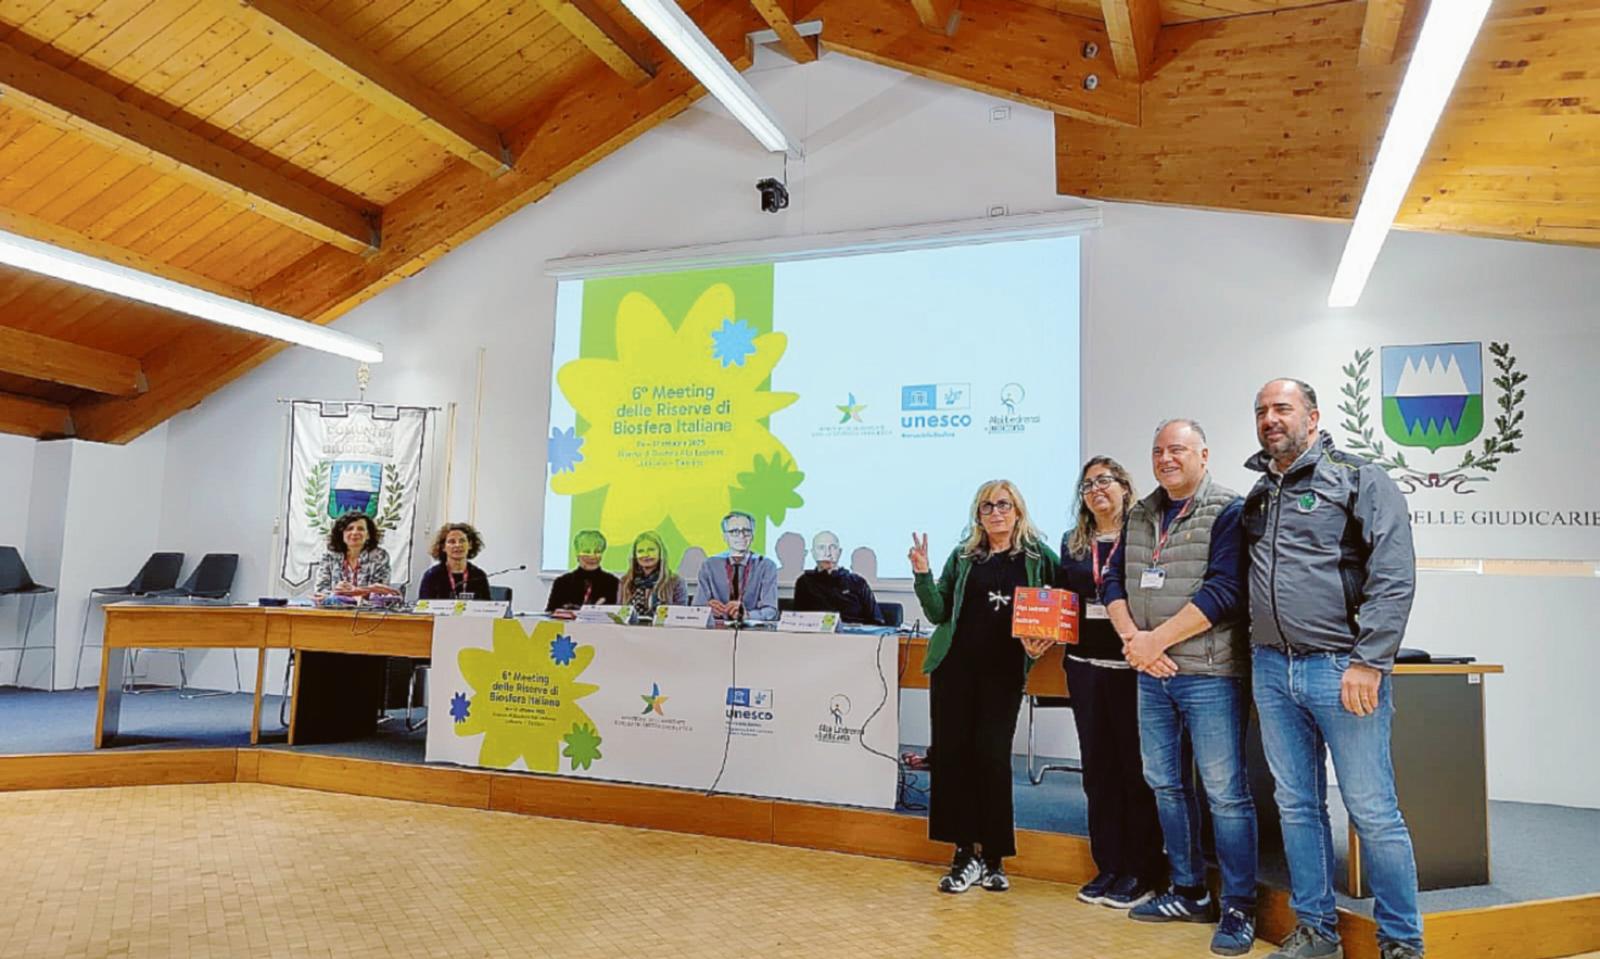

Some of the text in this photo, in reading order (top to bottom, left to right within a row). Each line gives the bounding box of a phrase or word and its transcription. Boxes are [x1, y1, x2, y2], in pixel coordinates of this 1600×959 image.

[653, 384, 714, 400] Meeting
[617, 400, 731, 417] delle Riserve di
[614, 419, 732, 434] Biosfera Italiane
[901, 414, 972, 429] unesco
[1471, 511, 1600, 526] GIUDICARIE
[513, 672, 549, 685] Meeting
[492, 682, 559, 696] delle Riserve di
[490, 692, 560, 707] Biosfera Italiane
[726, 709, 773, 720] unesco
